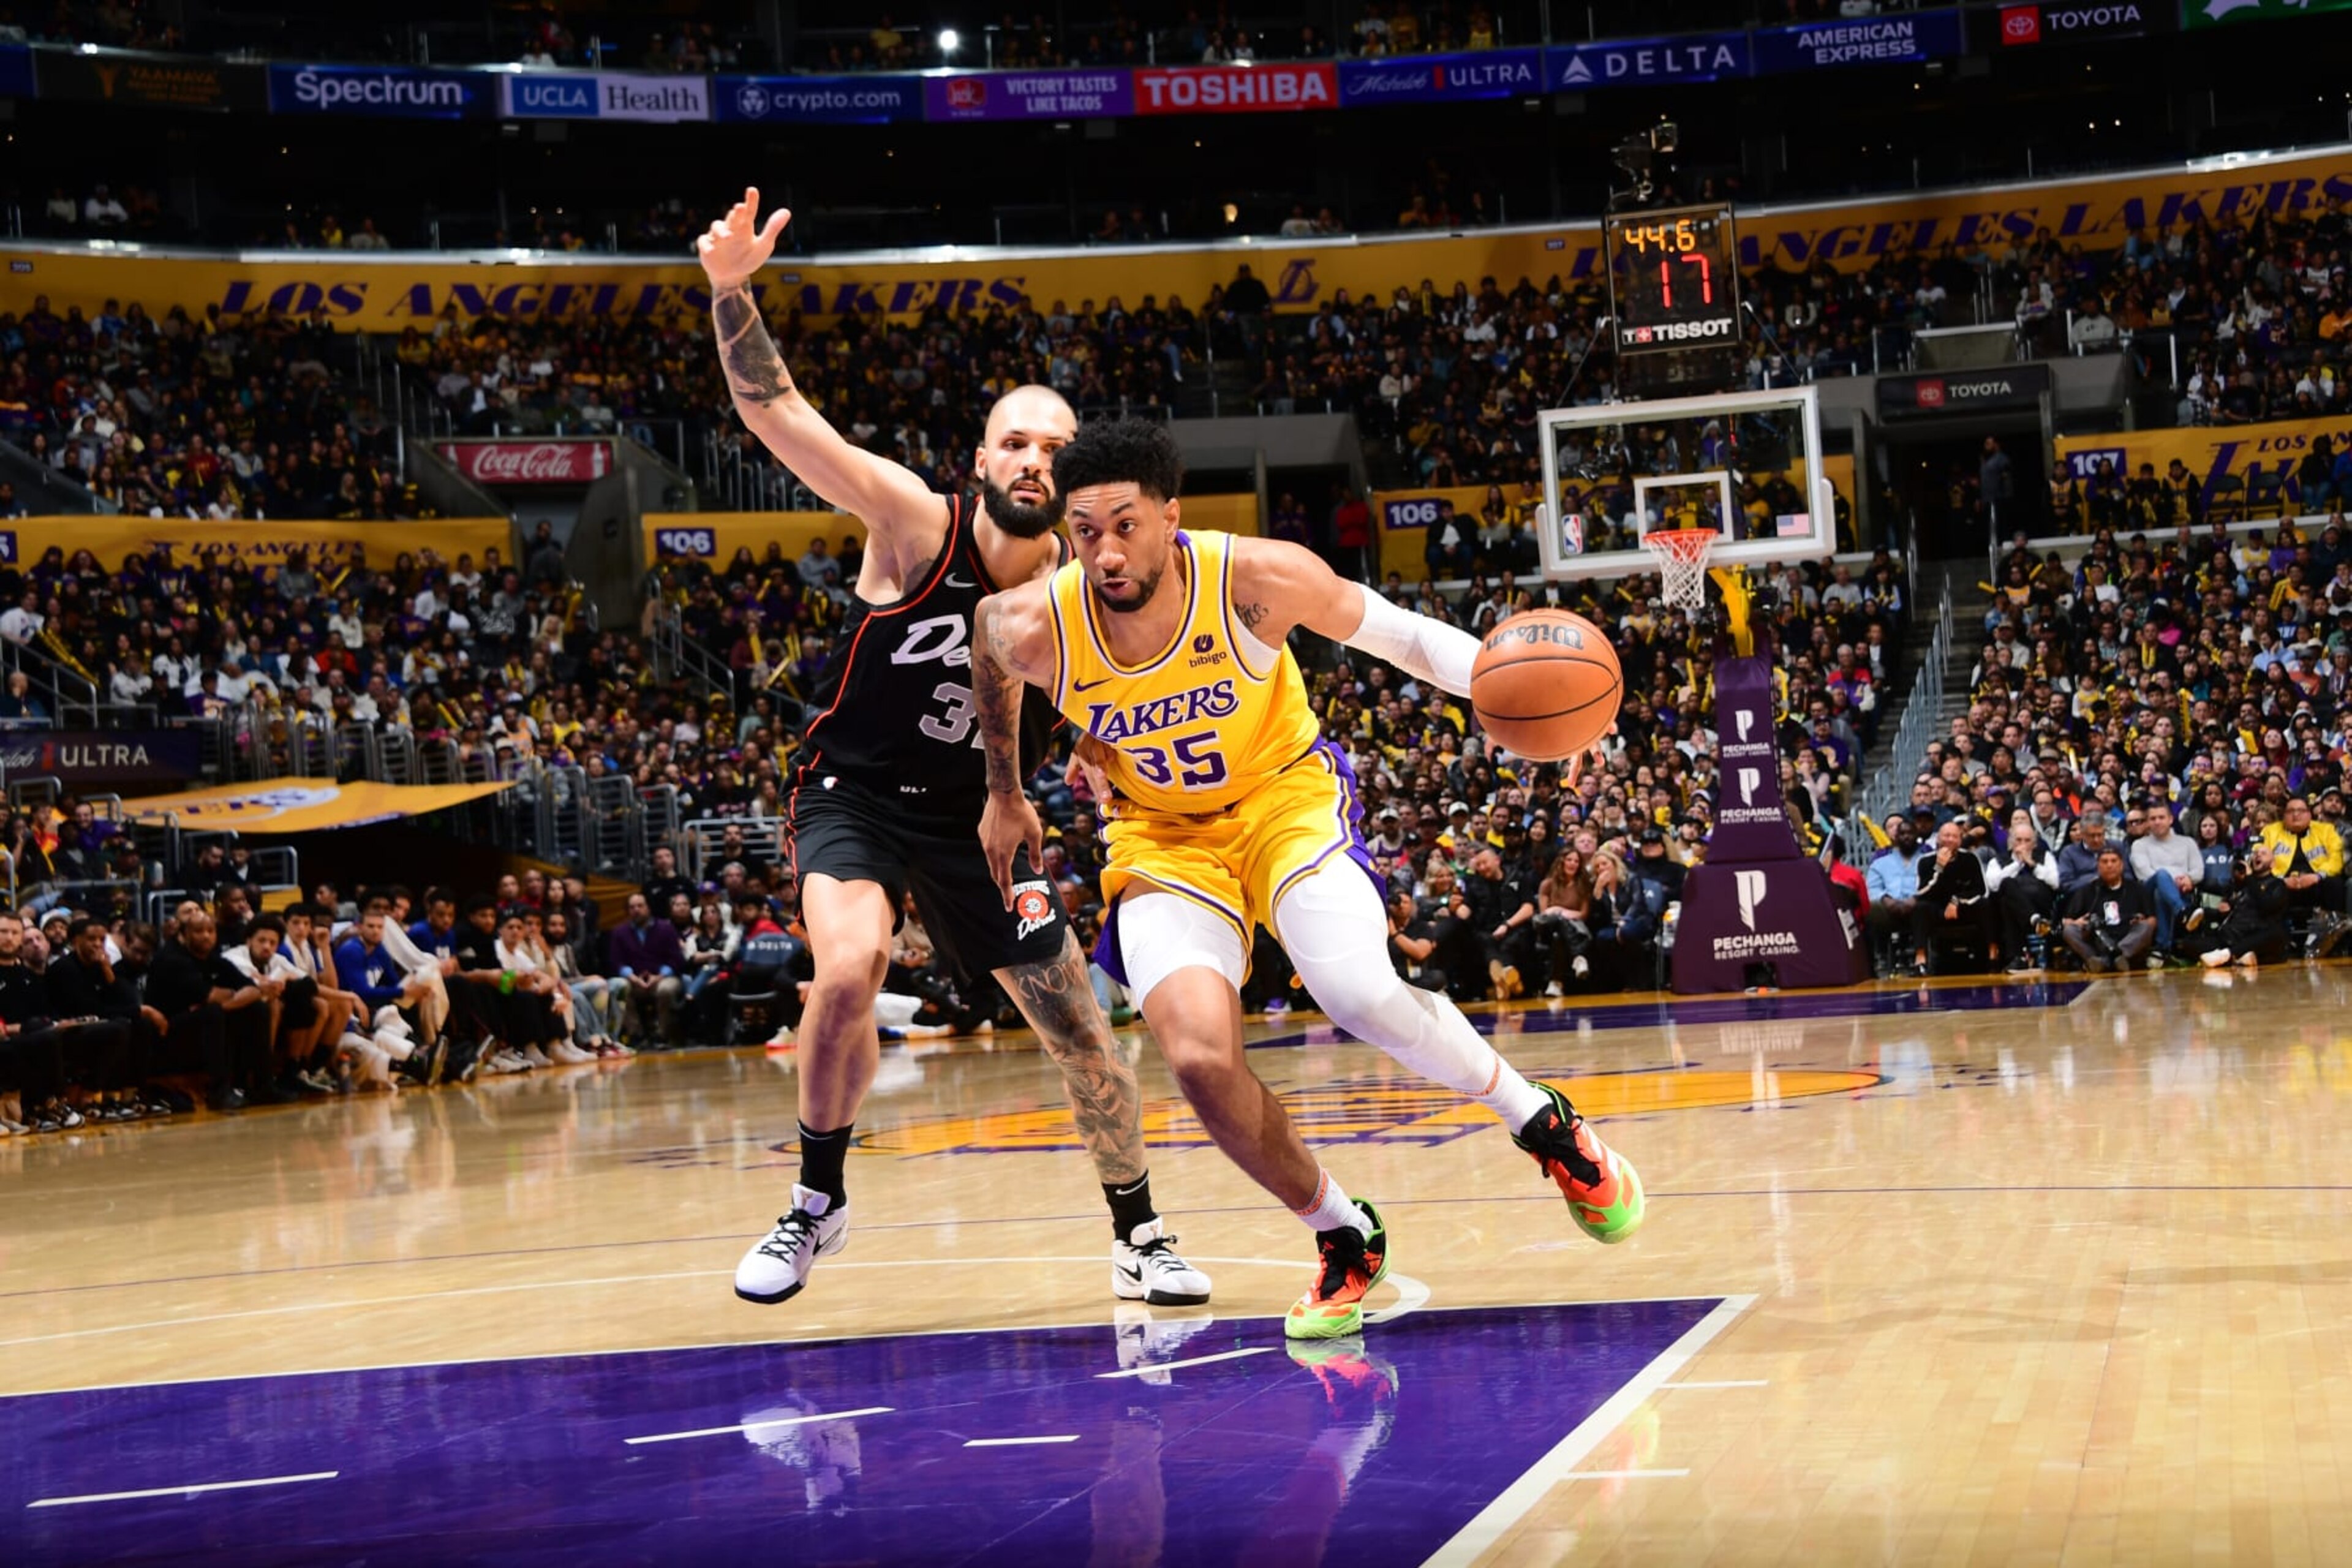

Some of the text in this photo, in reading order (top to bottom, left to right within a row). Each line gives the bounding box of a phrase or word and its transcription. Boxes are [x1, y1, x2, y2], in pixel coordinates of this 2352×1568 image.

[2046, 5, 2141, 31] TOYOTA
[1798, 21, 1913, 48] AMERICAN
[1604, 44, 1735, 78] DELTA
[1814, 39, 1915, 64] EXPRESS
[1005, 76, 1118, 95] VICTORY TASTES
[1447, 63, 1531, 86] ULTRA
[294, 72, 461, 110] Spectrum
[521, 86, 698, 112] UCLA Health
[773, 89, 899, 111] crypto.com
[1140, 72, 1326, 107] TOSHIBA
[1025, 94, 1102, 113] LIKE TACOS
[1624, 219, 1695, 254] 44.6
[1660, 253, 1711, 308] 17
[219, 281, 369, 315] LOS
[385, 281, 712, 316] ANGELES
[1652, 318, 1733, 342] TISSOT
[1948, 381, 2010, 397] TOYOTA
[2256, 433, 2306, 452] LOS
[1390, 502, 1437, 525] 106
[190, 541, 237, 556] LOS
[662, 531, 711, 554] 106
[1486, 630, 1584, 651] Wilson
[1189, 651, 1227, 668] bibigo
[1087, 679, 1240, 744] LAKERS
[61, 744, 149, 766] ULTRA
[1121, 730, 1227, 787] 35
[1722, 742, 1770, 753] PECHANGA
[1720, 807, 1781, 818] PECHANGA
[1713, 932, 1796, 951] PECHANGA
[1714, 948, 1754, 960] RESORT
